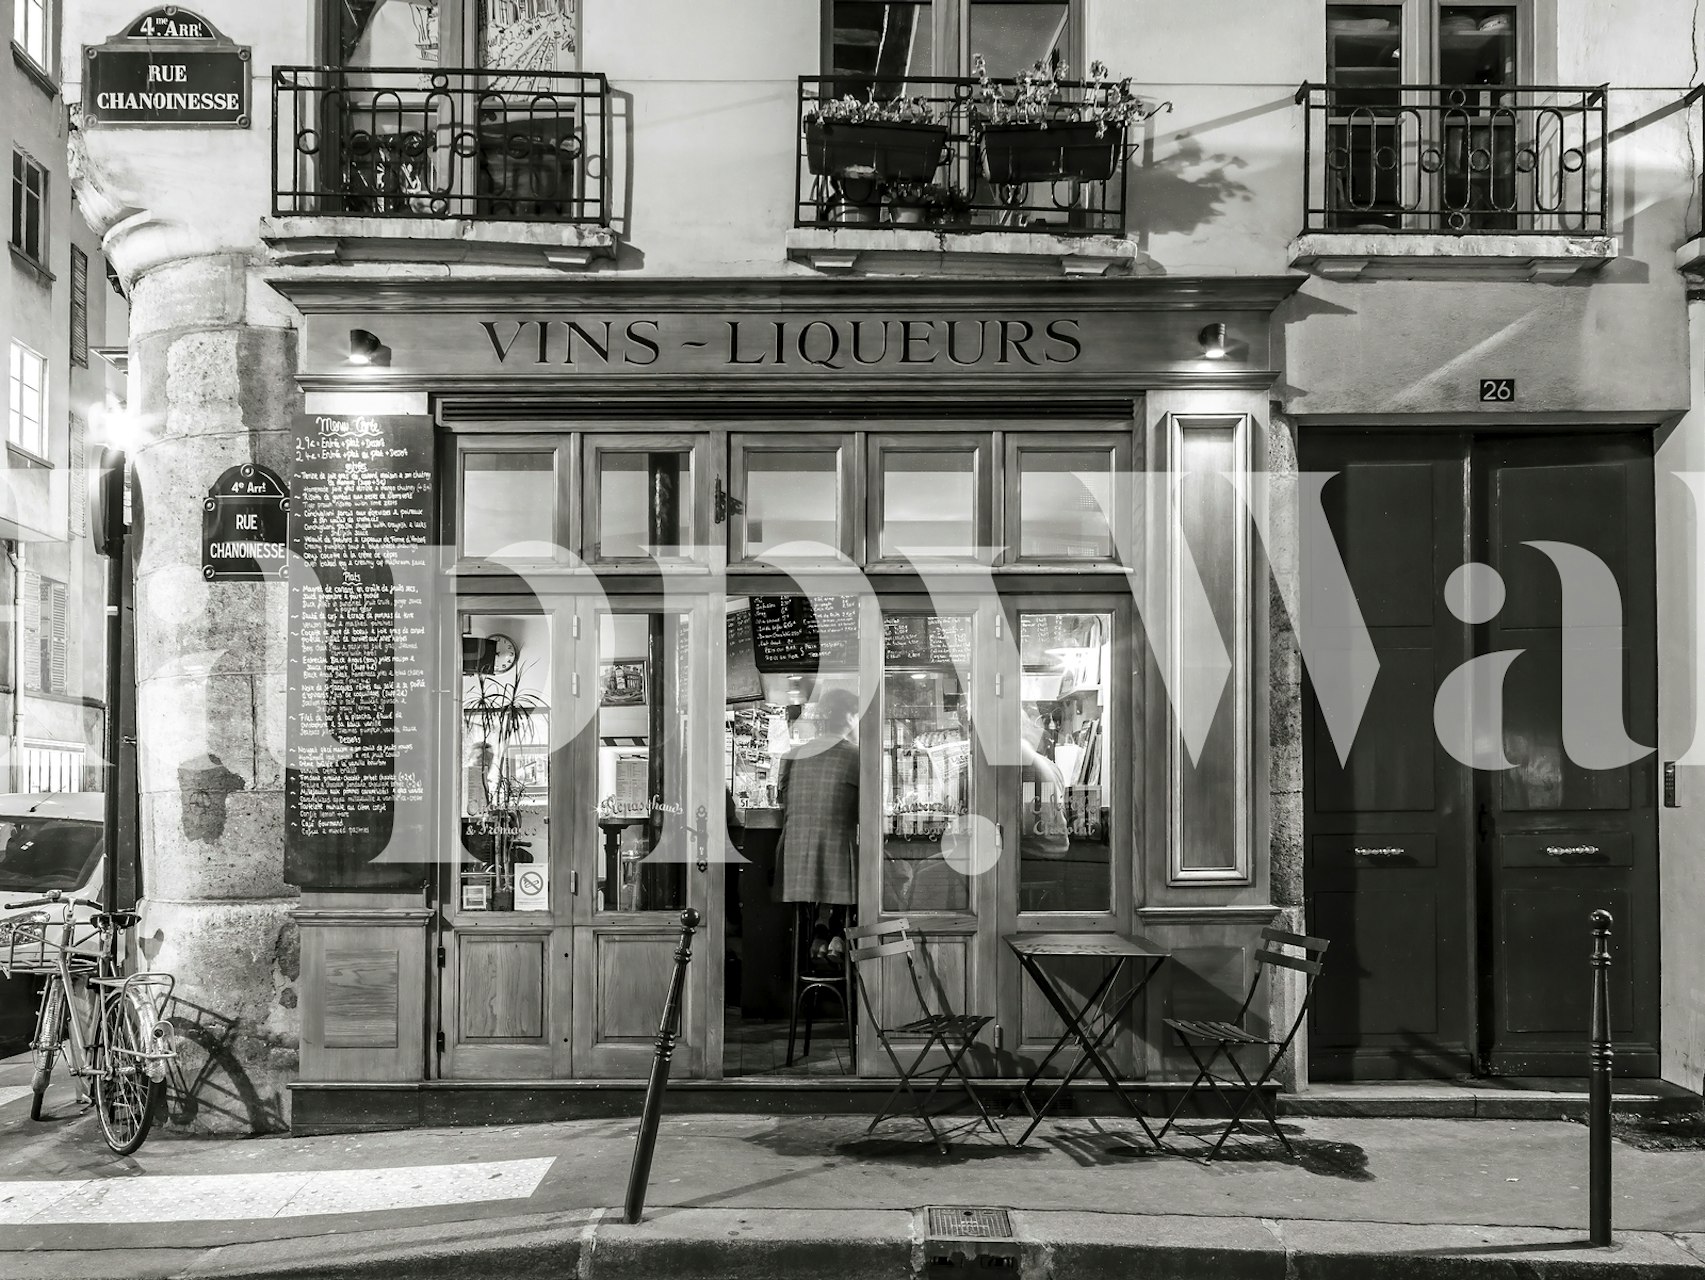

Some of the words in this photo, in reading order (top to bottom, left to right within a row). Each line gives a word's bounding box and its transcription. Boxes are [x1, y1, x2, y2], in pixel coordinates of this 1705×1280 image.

[148, 65, 187, 82] RUE
[97, 92, 240, 110] CHANOINESSE
[479, 319, 662, 366] VINS
[724, 318, 1084, 370] LIQUEURS
[1483, 380, 1511, 400] 26
[315, 416, 349, 432] Menu
[236, 514, 258, 530] RUE
[210, 543, 285, 559] CHANOINESSE
[465, 825, 477, 836] &
